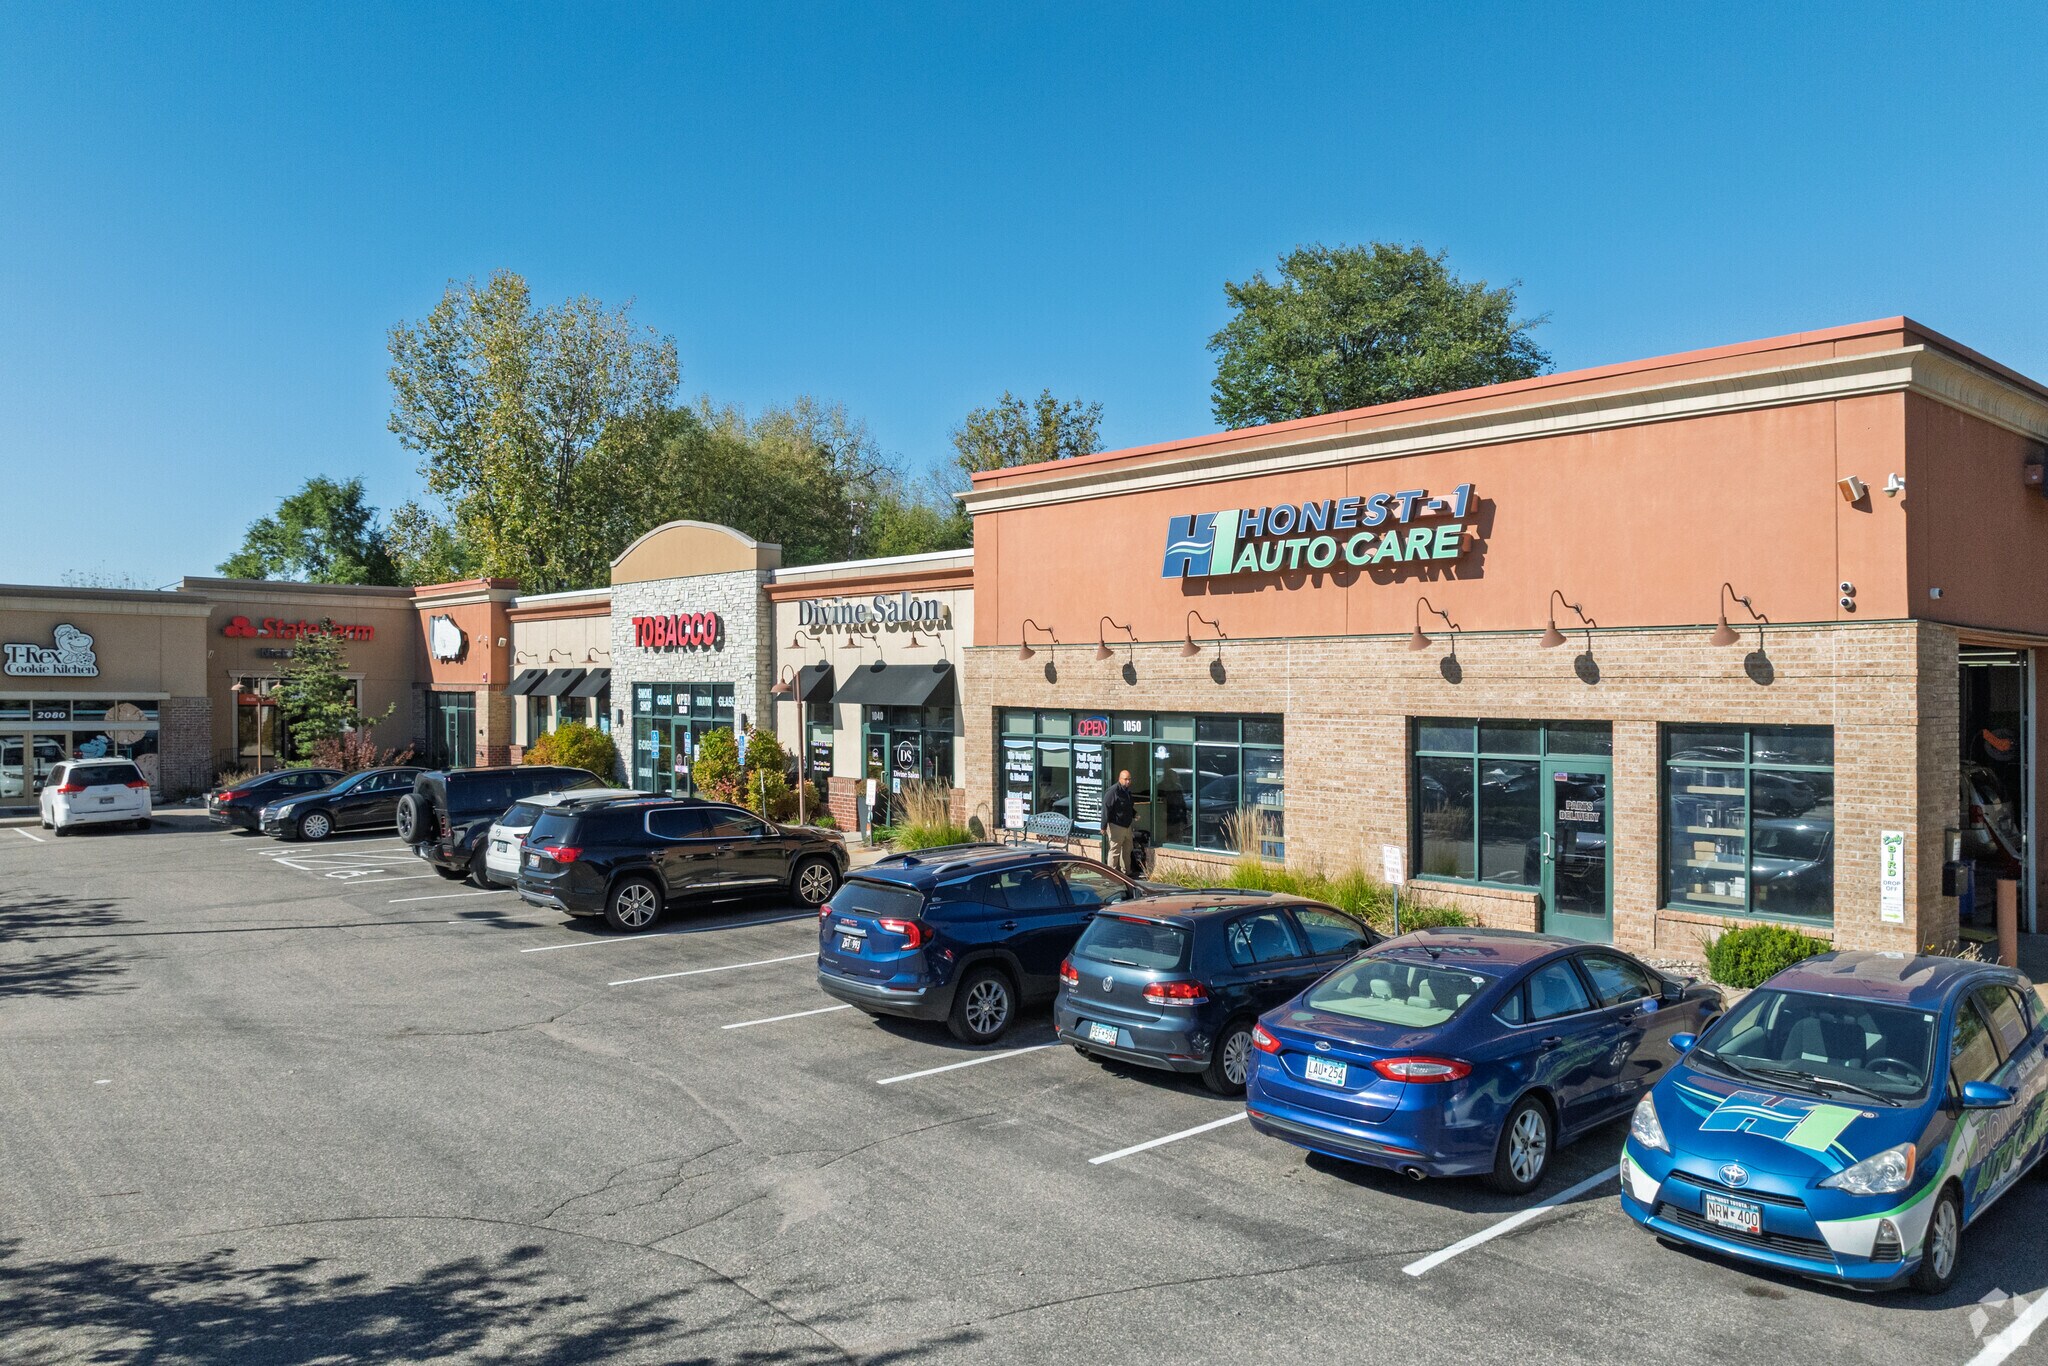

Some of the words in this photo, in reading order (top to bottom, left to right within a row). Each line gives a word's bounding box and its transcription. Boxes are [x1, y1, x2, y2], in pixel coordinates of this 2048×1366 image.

[1238, 484, 1471, 538] HONEST-1
[1232, 535, 1337, 574] AUTO
[1345, 524, 1462, 566] CARE
[798, 597, 867, 626] Divine
[873, 592, 939, 623] Salon
[632, 612, 716, 647] TOBACCO
[7, 646, 62, 664] T-Rex
[7, 664, 49, 674] Cookie
[53, 664, 95, 674] Kitchen
[37, 711, 66, 719] 2080
[872, 712, 883, 720] 1040
[1078, 720, 1106, 736] OPEN
[1123, 720, 1141, 732] 1050
[900, 752, 912, 762] DS
[894, 770, 907, 778] Divine
[907, 771, 919, 779] Salon
[1565, 800, 1593, 811] PARTS
[1559, 810, 1600, 822] DELIVERY
[1888, 845, 1896, 876] BIRD
[841, 918, 857, 926] GMC
[1308, 1062, 1324, 1075] LAU
[1328, 1067, 1343, 1079] 254
[1709, 1203, 1729, 1219] NRW
[1738, 1210, 1758, 1226] 400
